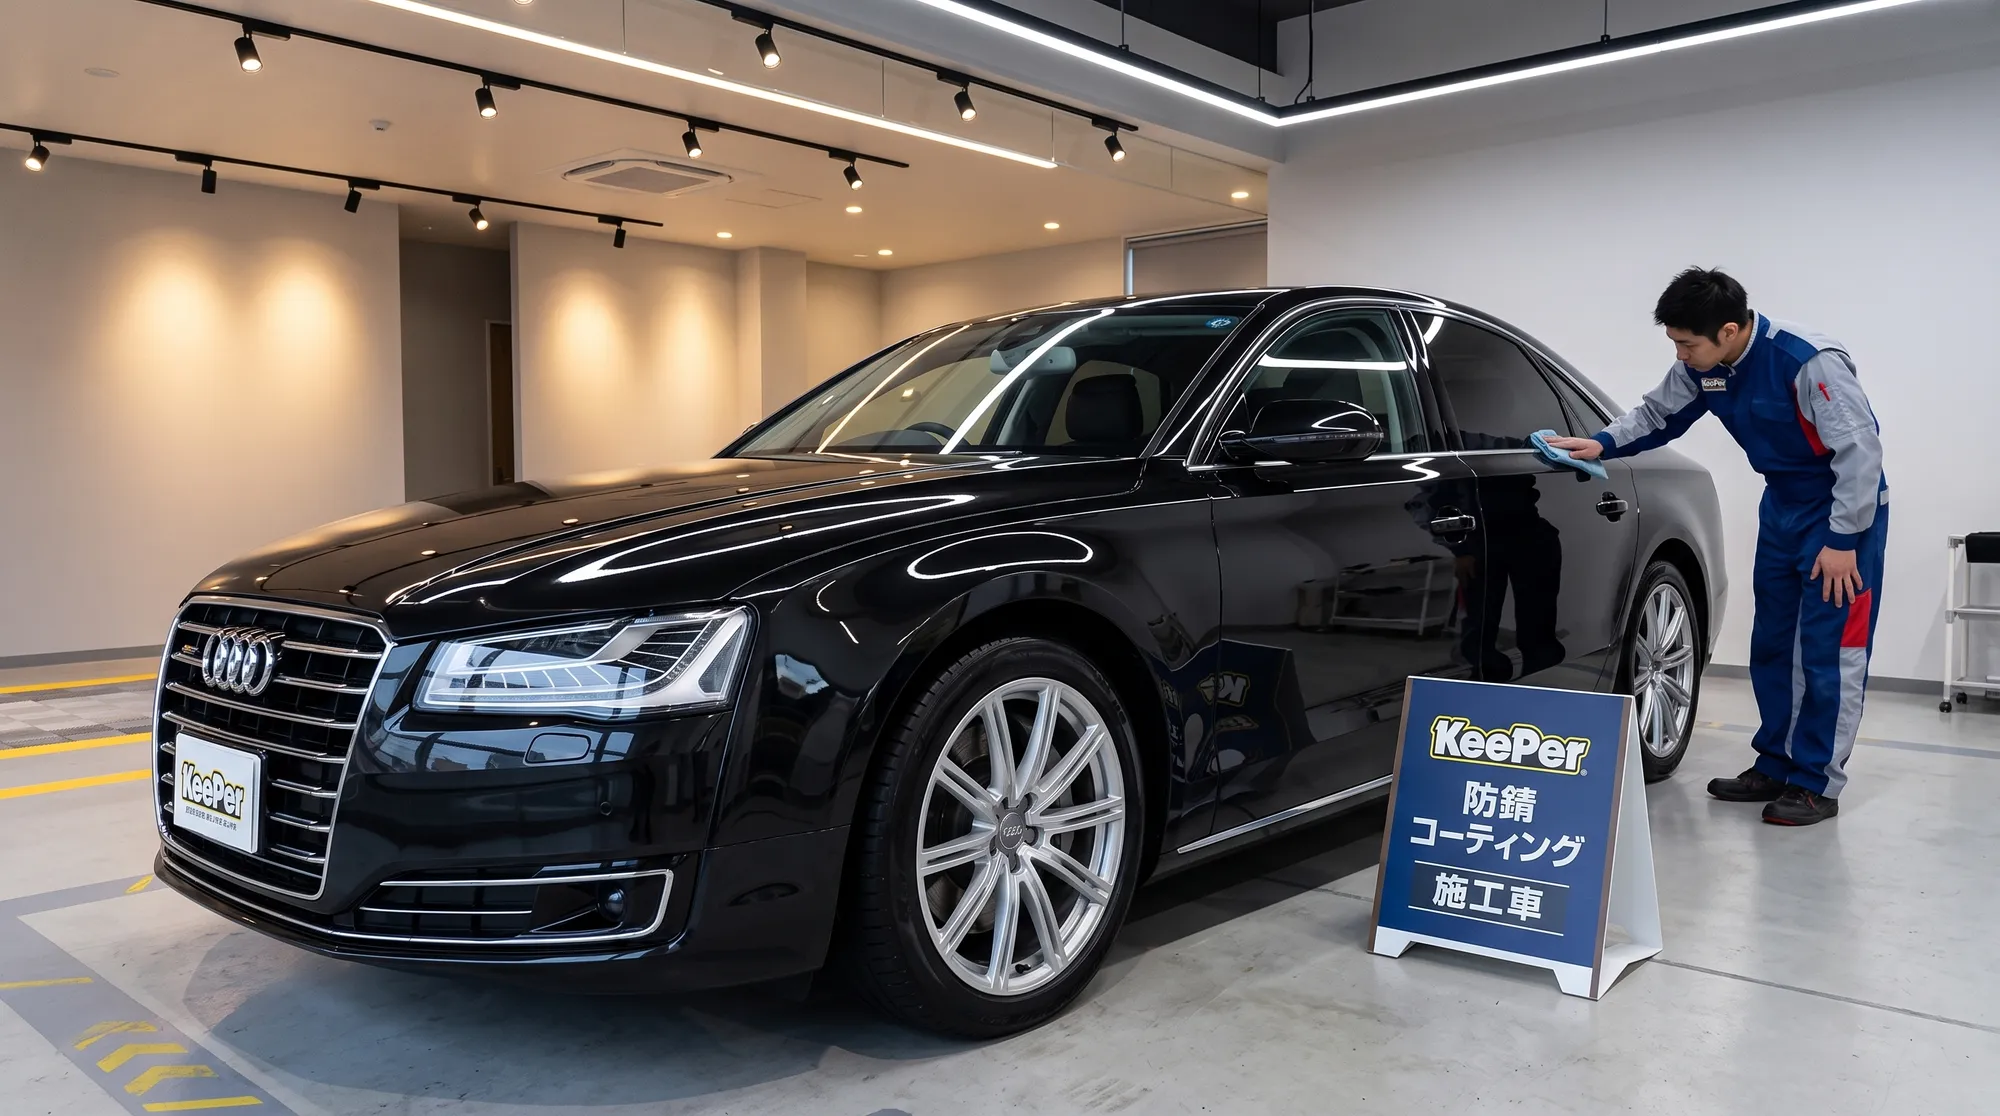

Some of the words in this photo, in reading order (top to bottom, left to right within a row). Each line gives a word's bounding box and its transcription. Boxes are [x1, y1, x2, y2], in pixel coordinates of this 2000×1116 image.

[1433, 718, 1588, 772] KeePer
[182, 761, 245, 818] KeePer
[1462, 780, 1537, 823] 防錆
[1410, 816, 1586, 868] コーティング
[1432, 872, 1544, 921] 施工車
